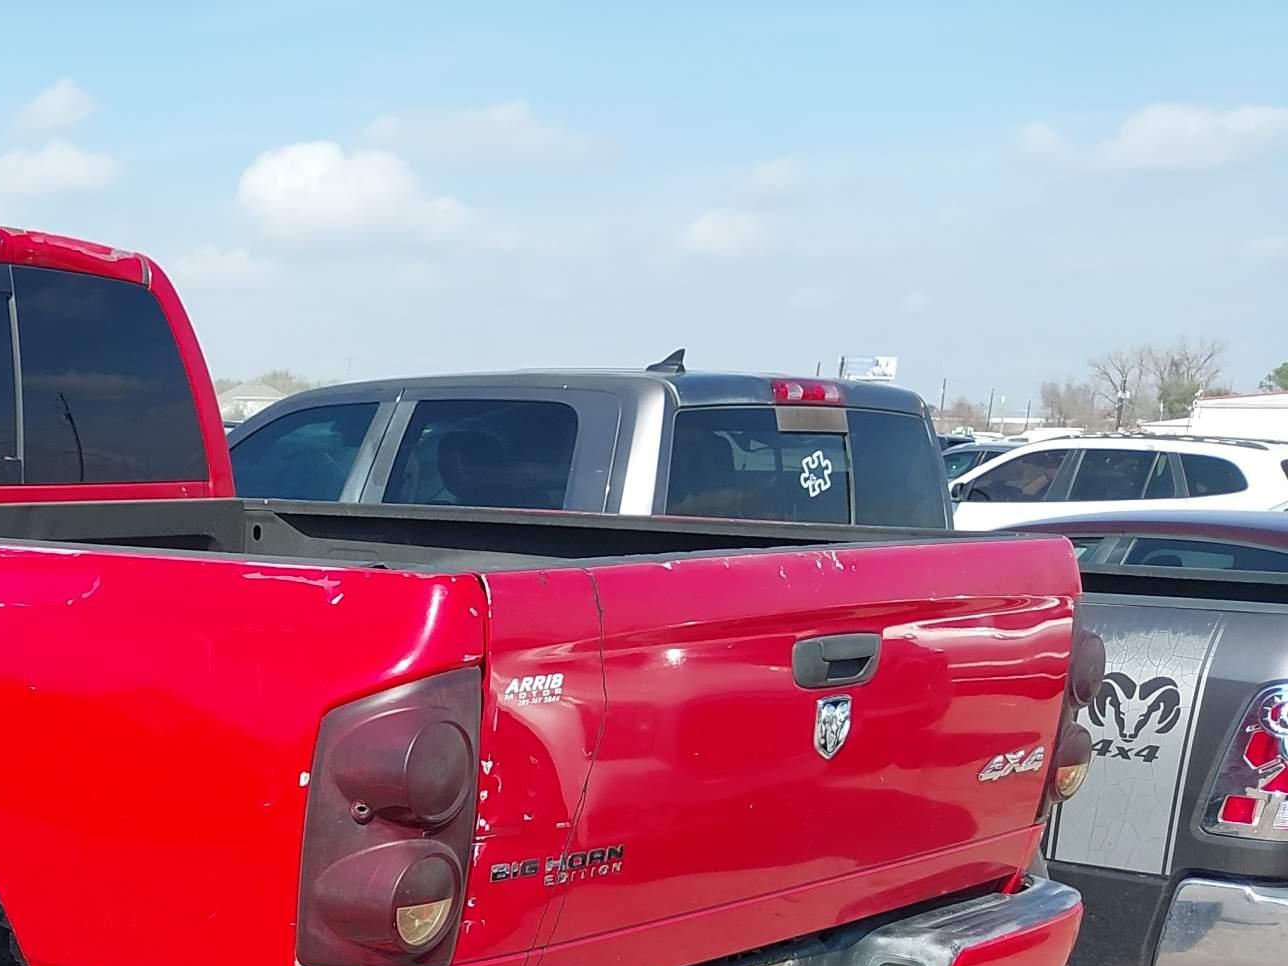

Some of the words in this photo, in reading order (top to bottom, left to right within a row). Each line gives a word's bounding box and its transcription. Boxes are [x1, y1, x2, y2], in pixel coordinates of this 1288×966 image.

[504, 688, 562, 701] MOTOR
[1092, 738, 1160, 763] 4x4
[490, 859, 540, 882] BIG
[545, 844, 625, 872] HORN
[544, 861, 622, 886] EDITION
